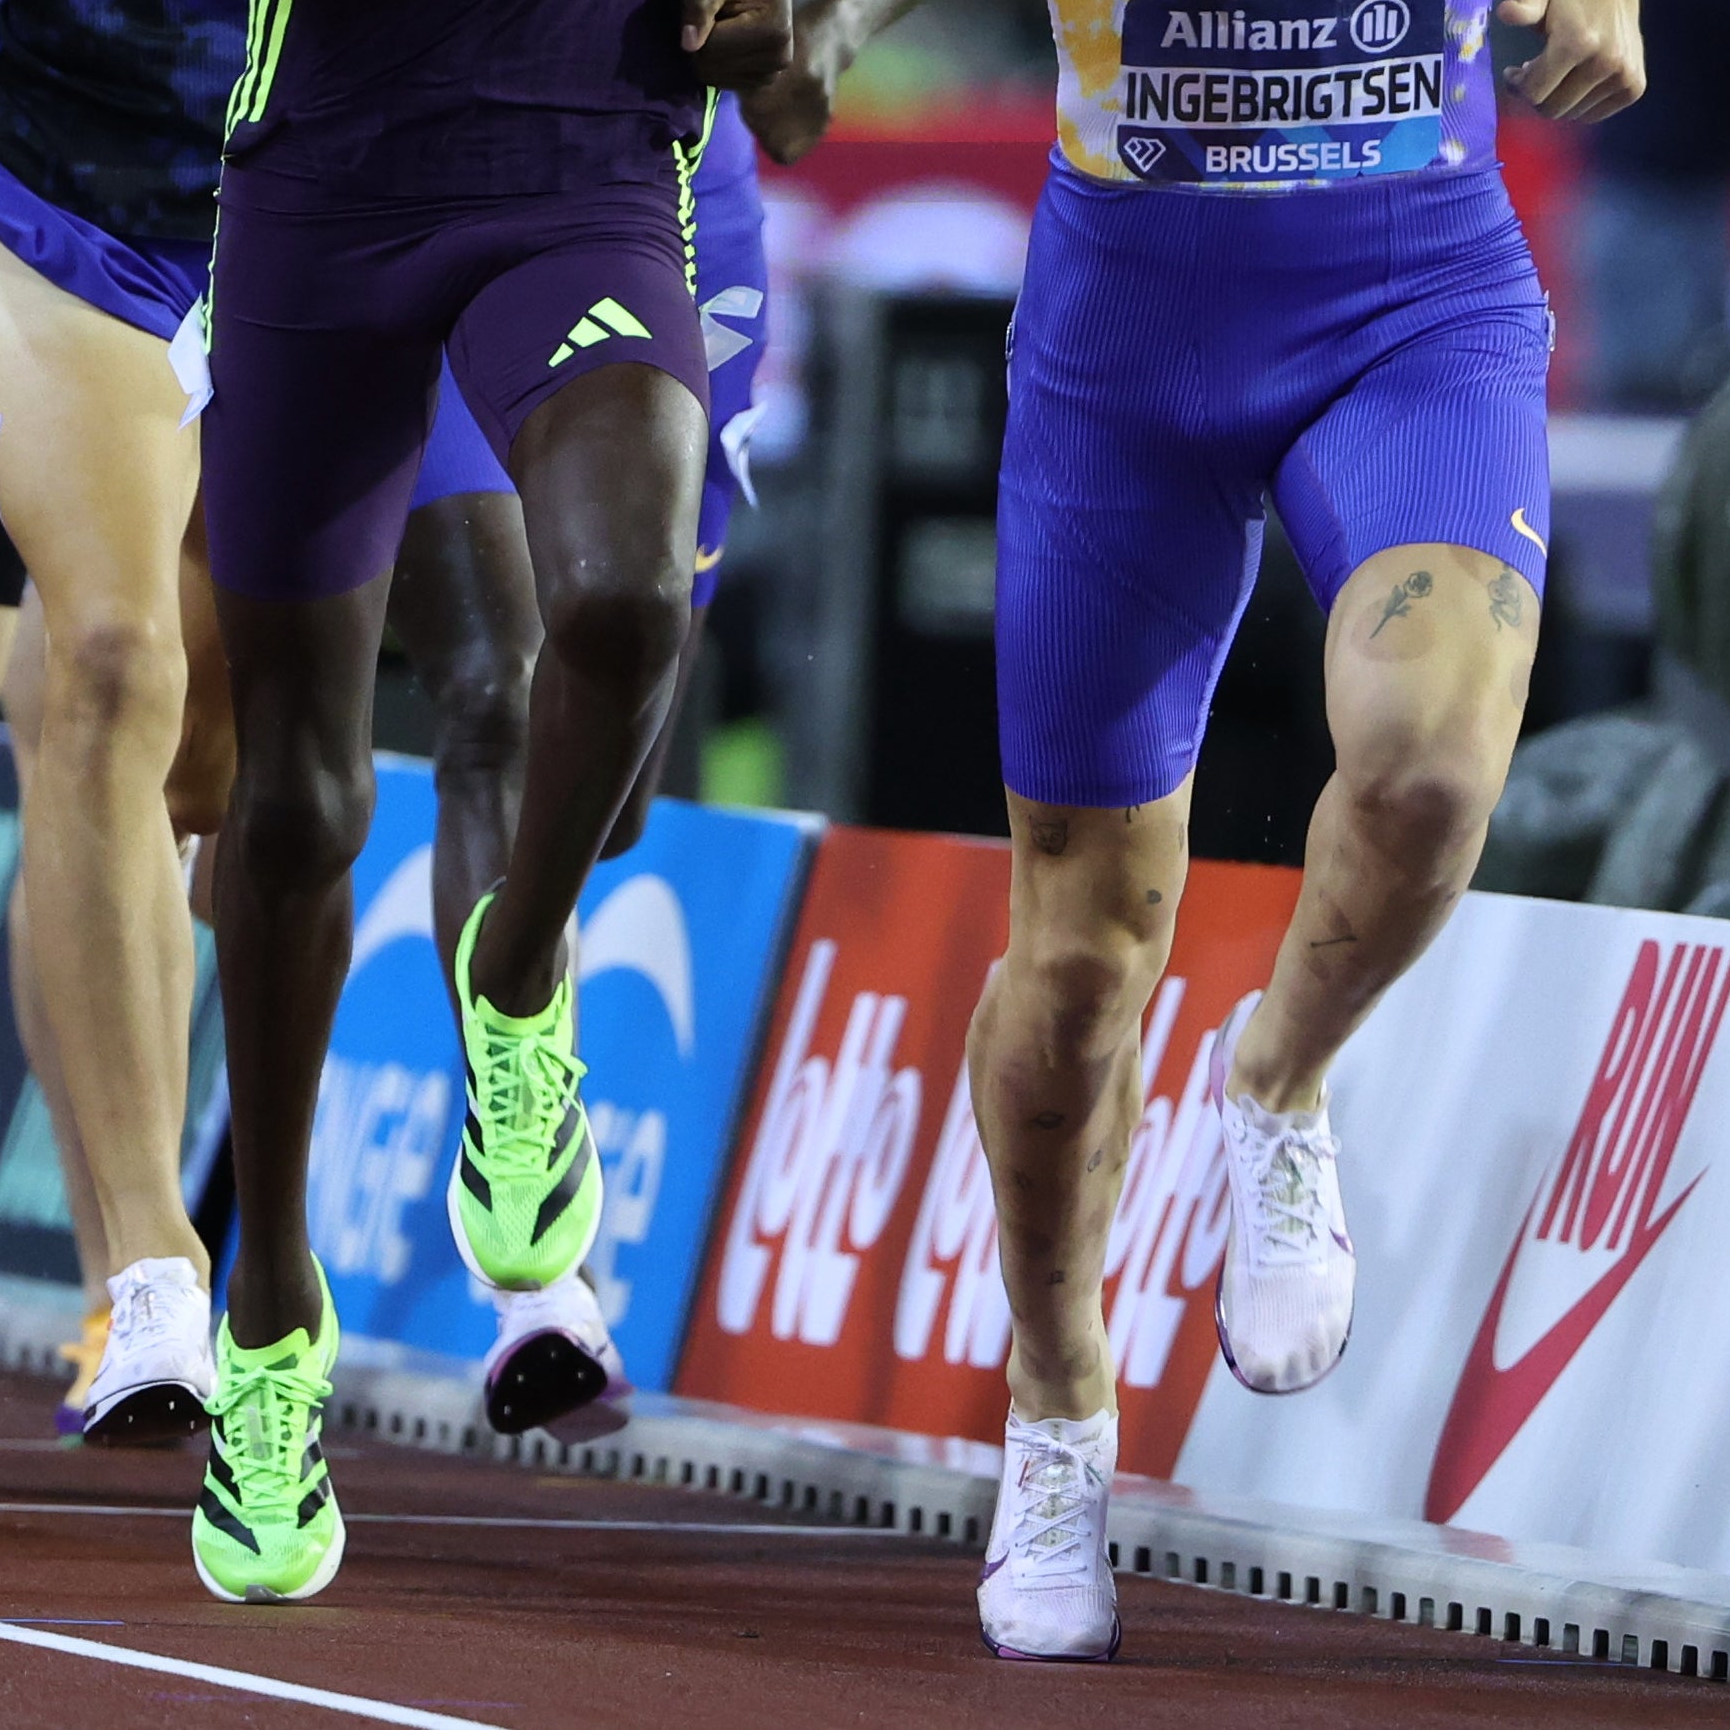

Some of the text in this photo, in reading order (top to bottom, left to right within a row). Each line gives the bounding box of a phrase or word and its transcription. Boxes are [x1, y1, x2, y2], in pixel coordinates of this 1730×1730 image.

[1161, 10, 1338, 51] Allianz
[1126, 59, 1442, 122] INGEBRIGTSEN
[1205, 139, 1381, 174] BRUSSELS
[716, 938, 922, 1346] lotto
